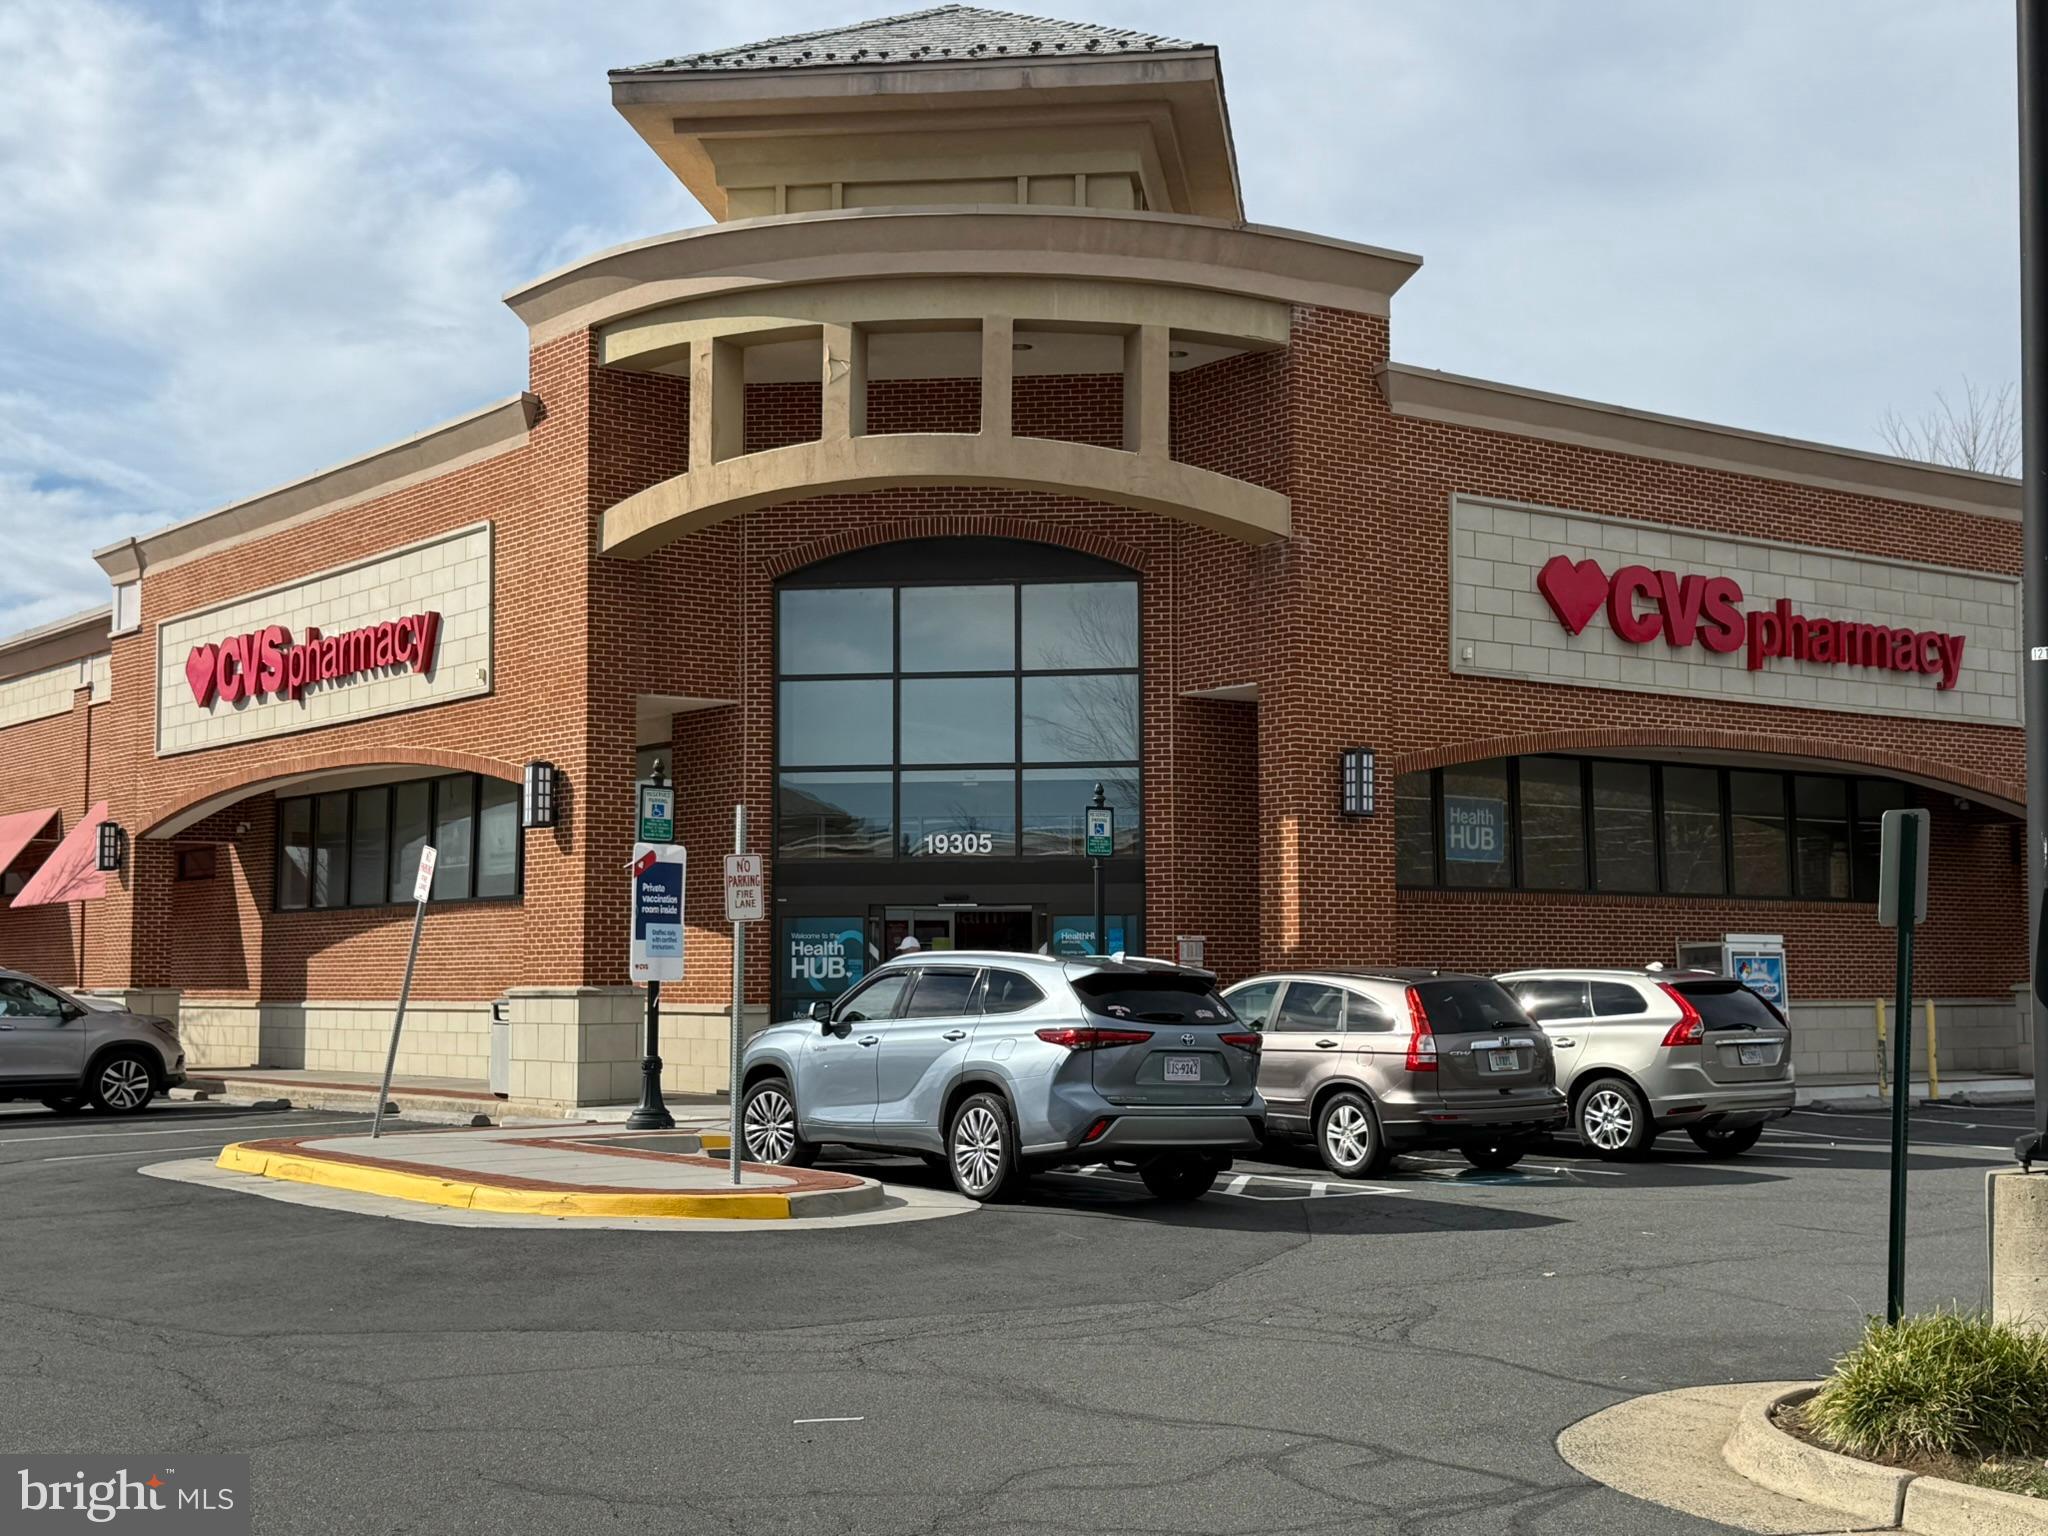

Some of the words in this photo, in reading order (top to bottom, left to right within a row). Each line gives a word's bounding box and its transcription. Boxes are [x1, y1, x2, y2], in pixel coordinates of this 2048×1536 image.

[1607, 564, 1745, 653] CVS
[1747, 597, 1966, 690] pharmacy
[216, 624, 292, 702] CVS
[288, 611, 442, 700] pharmacy
[1450, 807, 1494, 826] Health
[924, 833, 993, 854] 19305
[1450, 825, 1495, 850] HUB
[736, 860, 751, 873] NO
[642, 883, 666, 893] Private
[728, 875, 761, 887] PARKING
[642, 894, 678, 904] vaccination
[736, 889, 754, 899] FIRE
[641, 905, 660, 914] room
[660, 905, 678, 915] inside
[735, 899, 757, 909] LANE
[791, 941, 845, 956] Health
[791, 957, 846, 979] HUB
